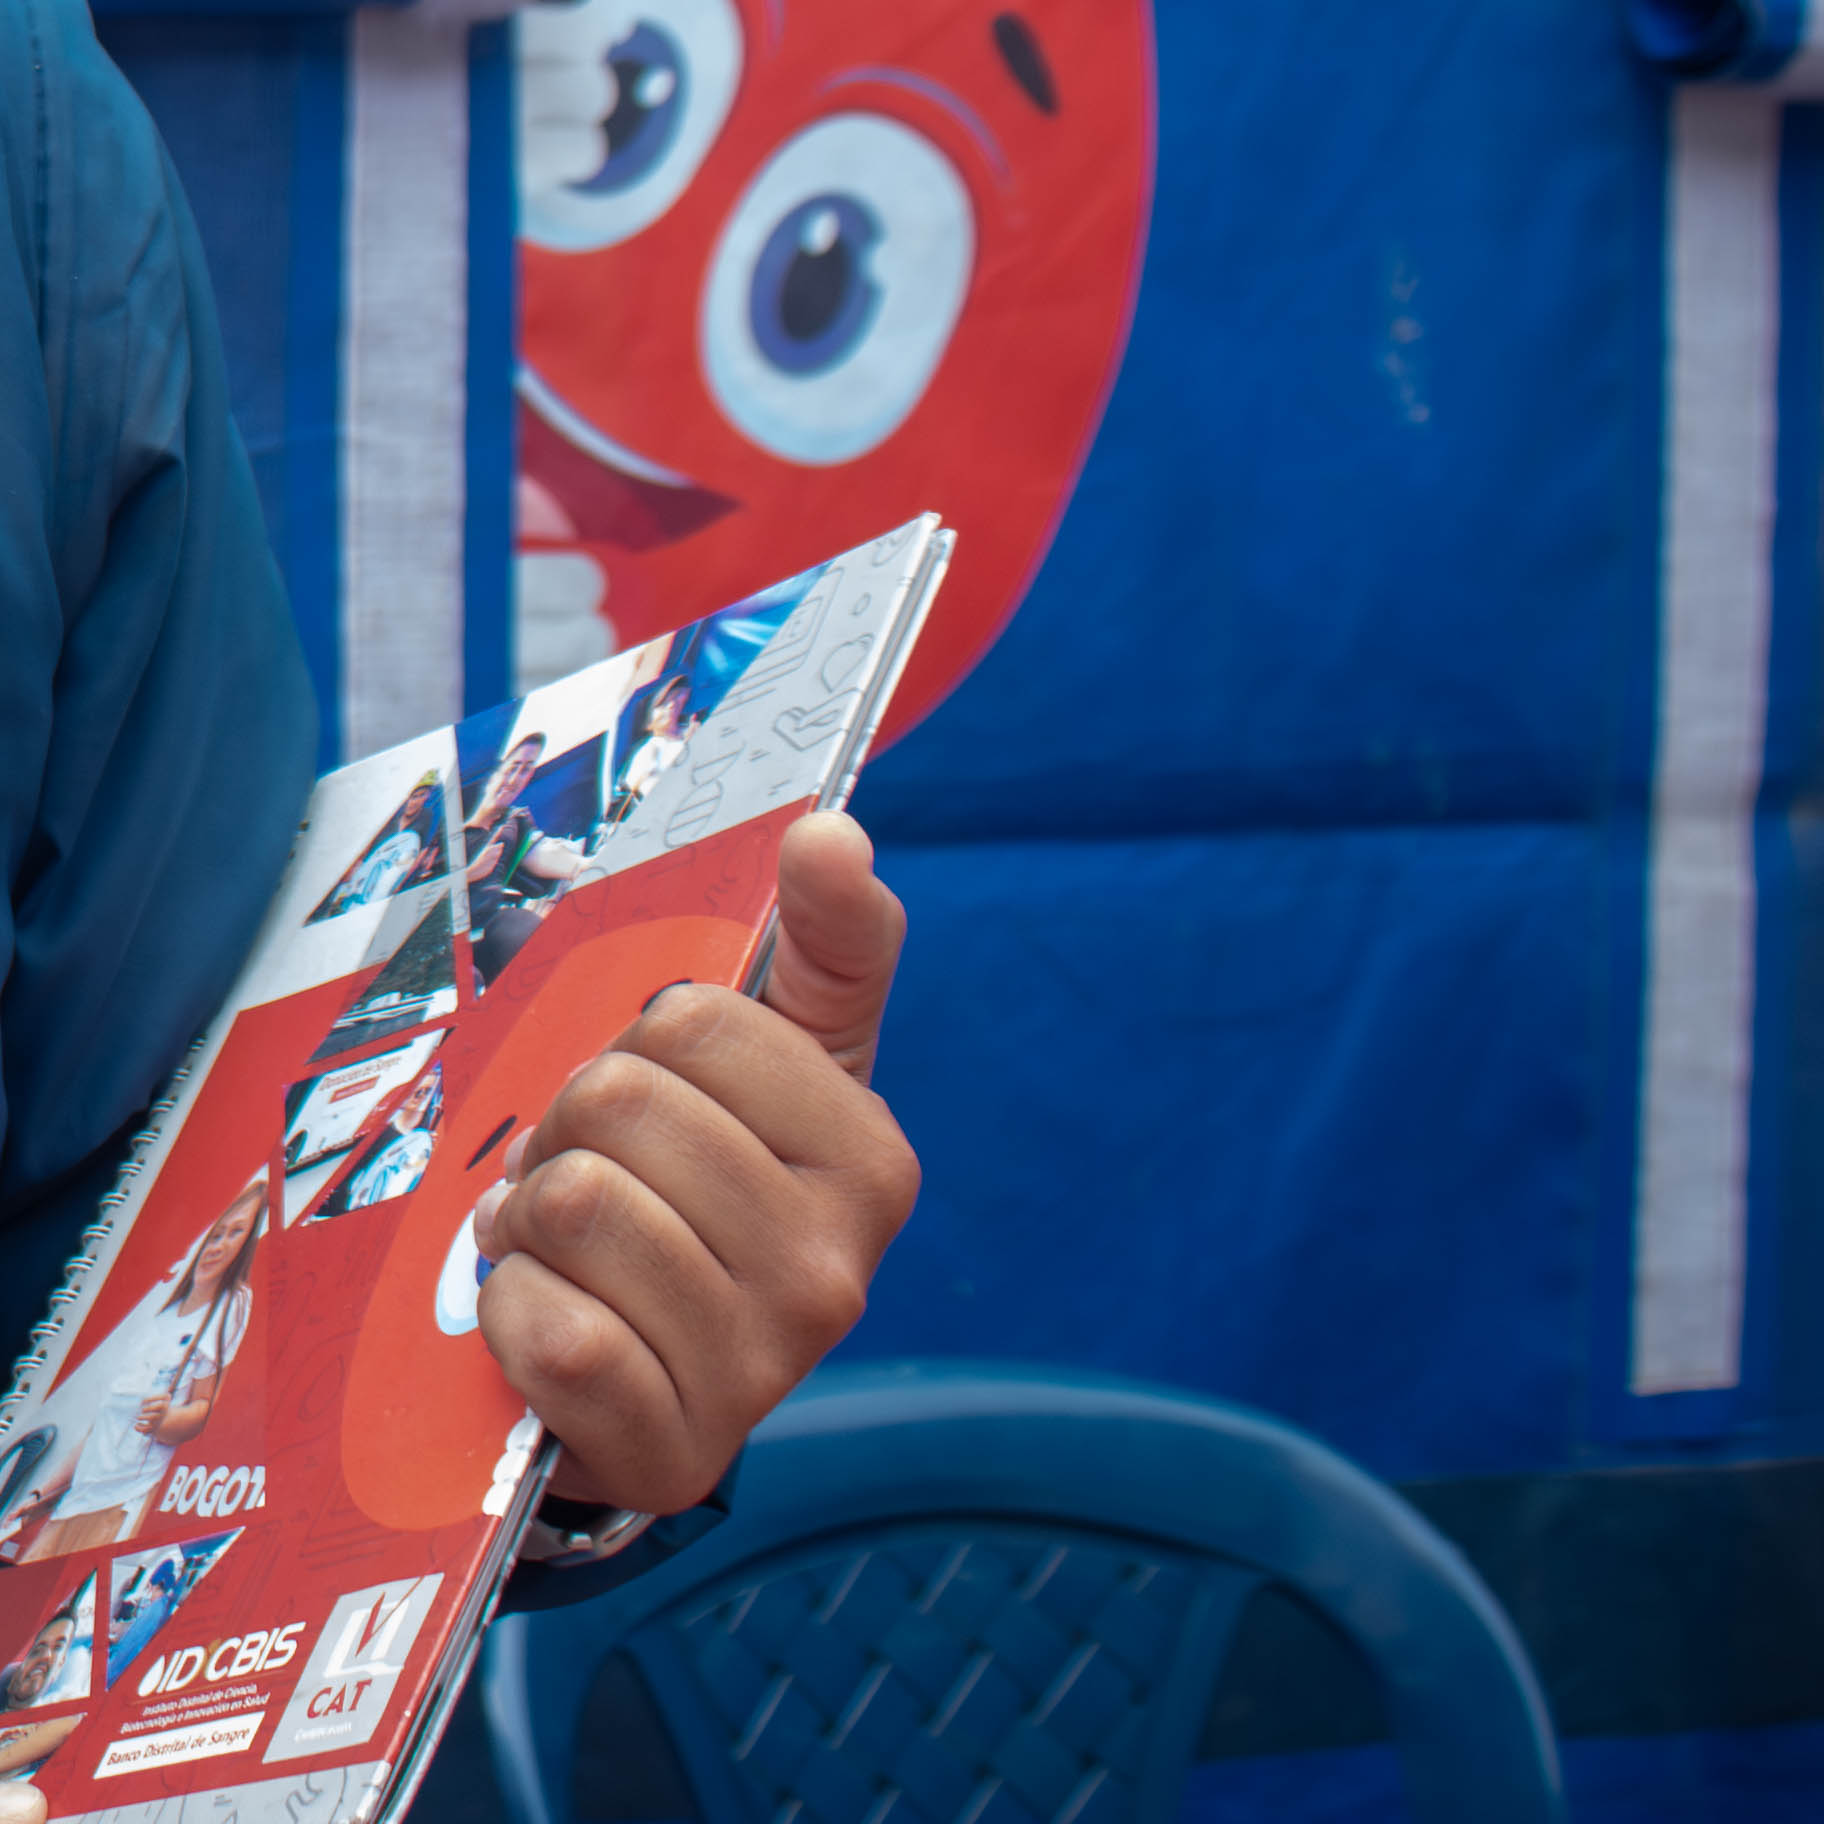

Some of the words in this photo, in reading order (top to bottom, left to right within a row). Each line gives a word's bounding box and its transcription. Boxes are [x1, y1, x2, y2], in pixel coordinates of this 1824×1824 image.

[159, 1465, 266, 1517] BOGOT
[306, 1679, 373, 1719] CAT
[107, 1750, 141, 1766] Banco
[144, 1736, 191, 1757] Distrital
[191, 1736, 207, 1749] de
[208, 1728, 250, 1745] Sangre
